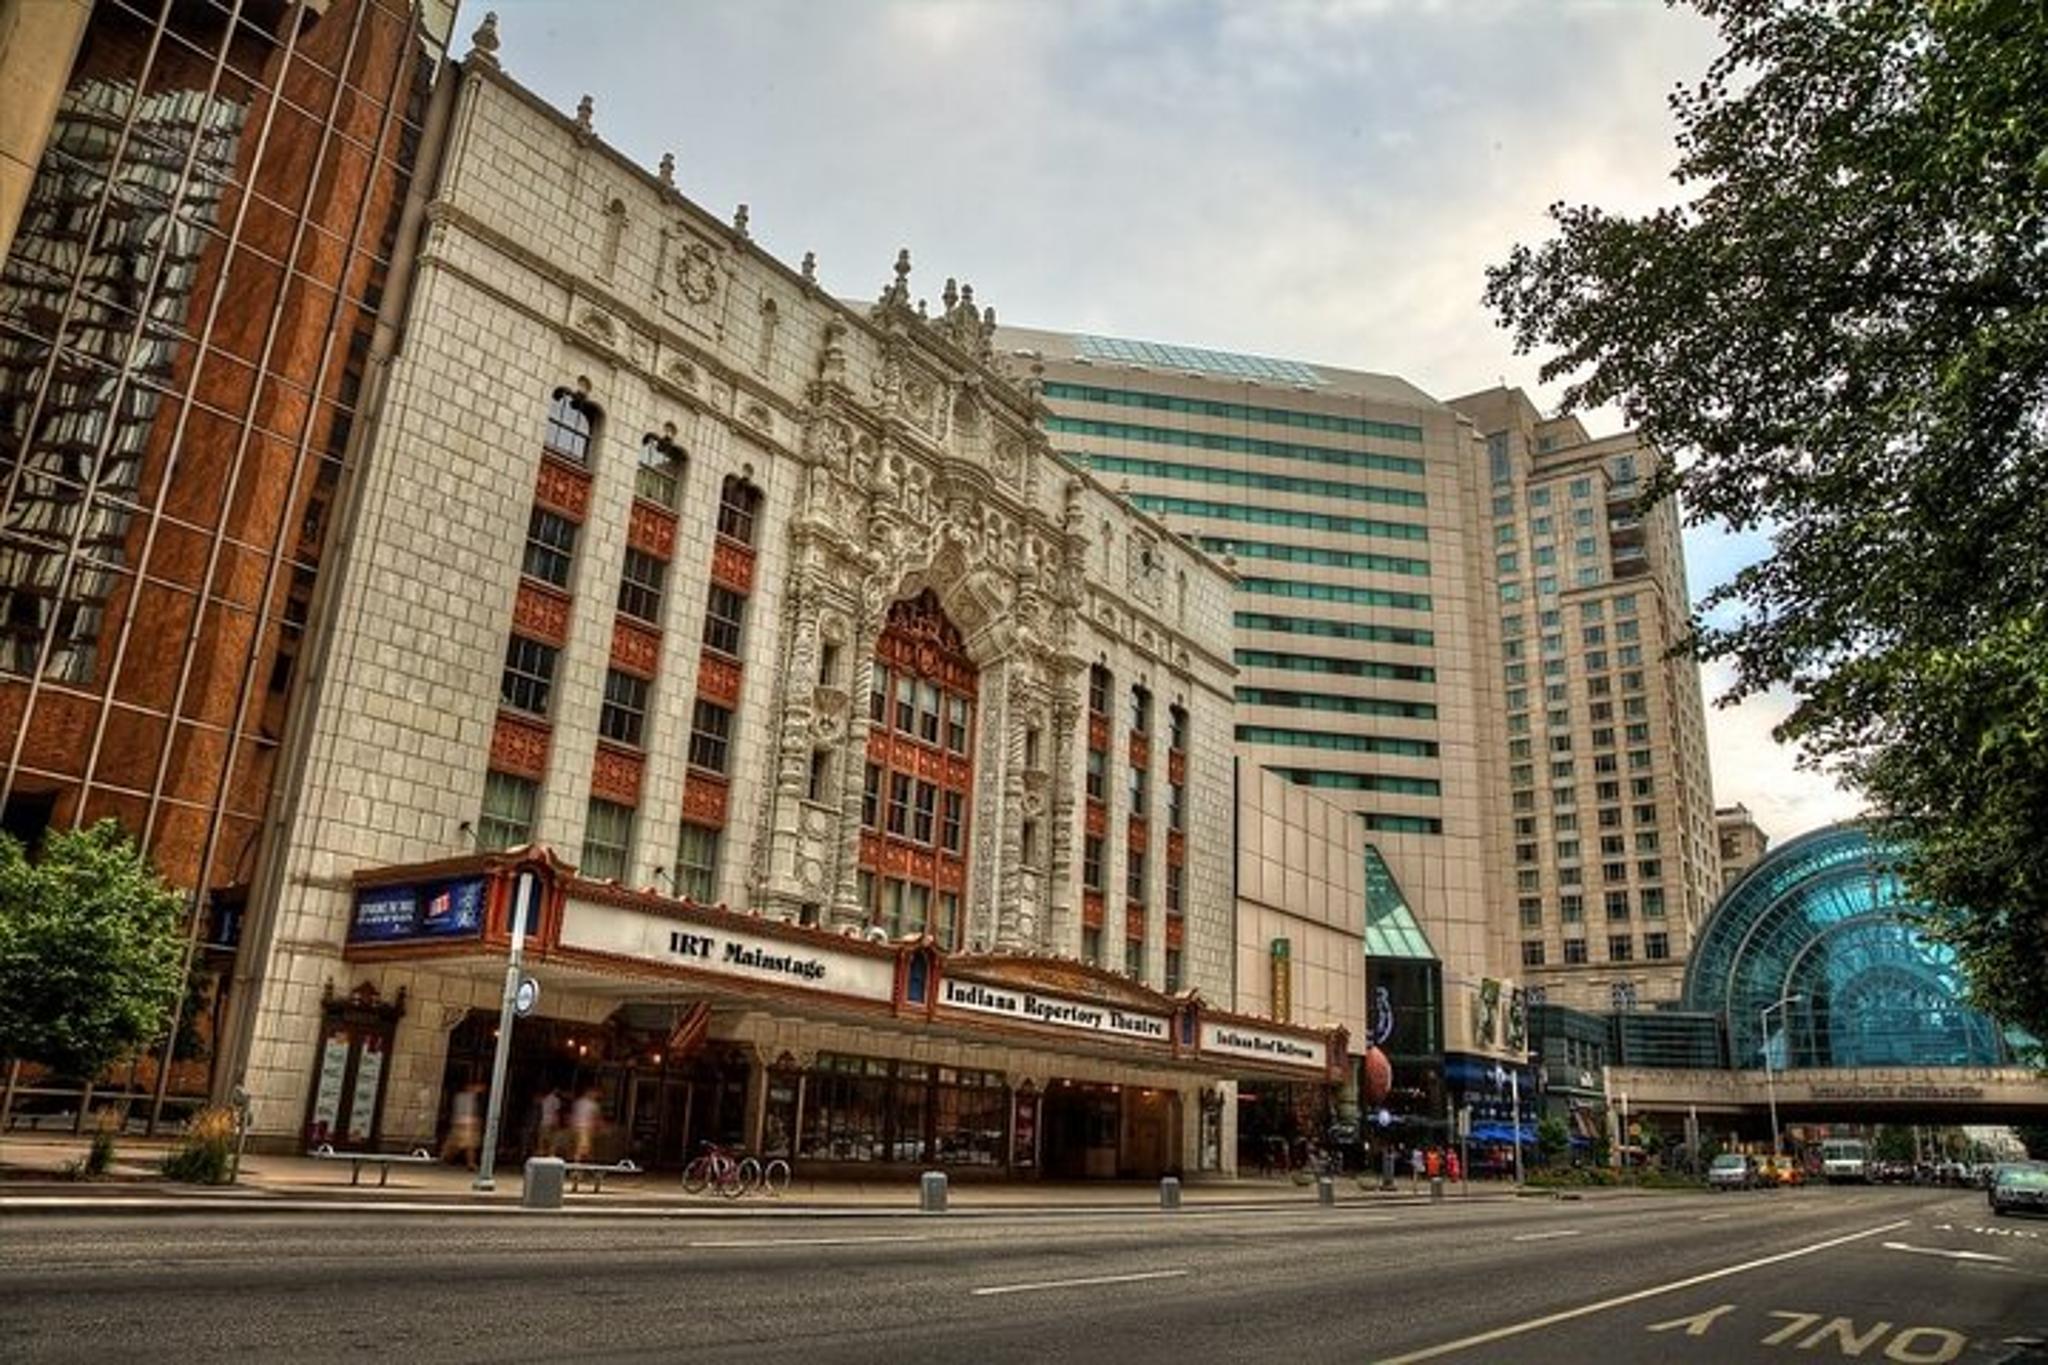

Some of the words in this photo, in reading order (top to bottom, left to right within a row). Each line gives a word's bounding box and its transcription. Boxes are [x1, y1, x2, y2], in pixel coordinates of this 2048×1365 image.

[669, 932, 715, 958] IRT
[722, 941, 826, 980] Mainstage
[946, 980, 1017, 1012] Indiana
[1023, 994, 1102, 1029] Repertory
[1109, 1011, 1163, 1036] Theatre
[1645, 1304, 1968, 1363] ONLY
